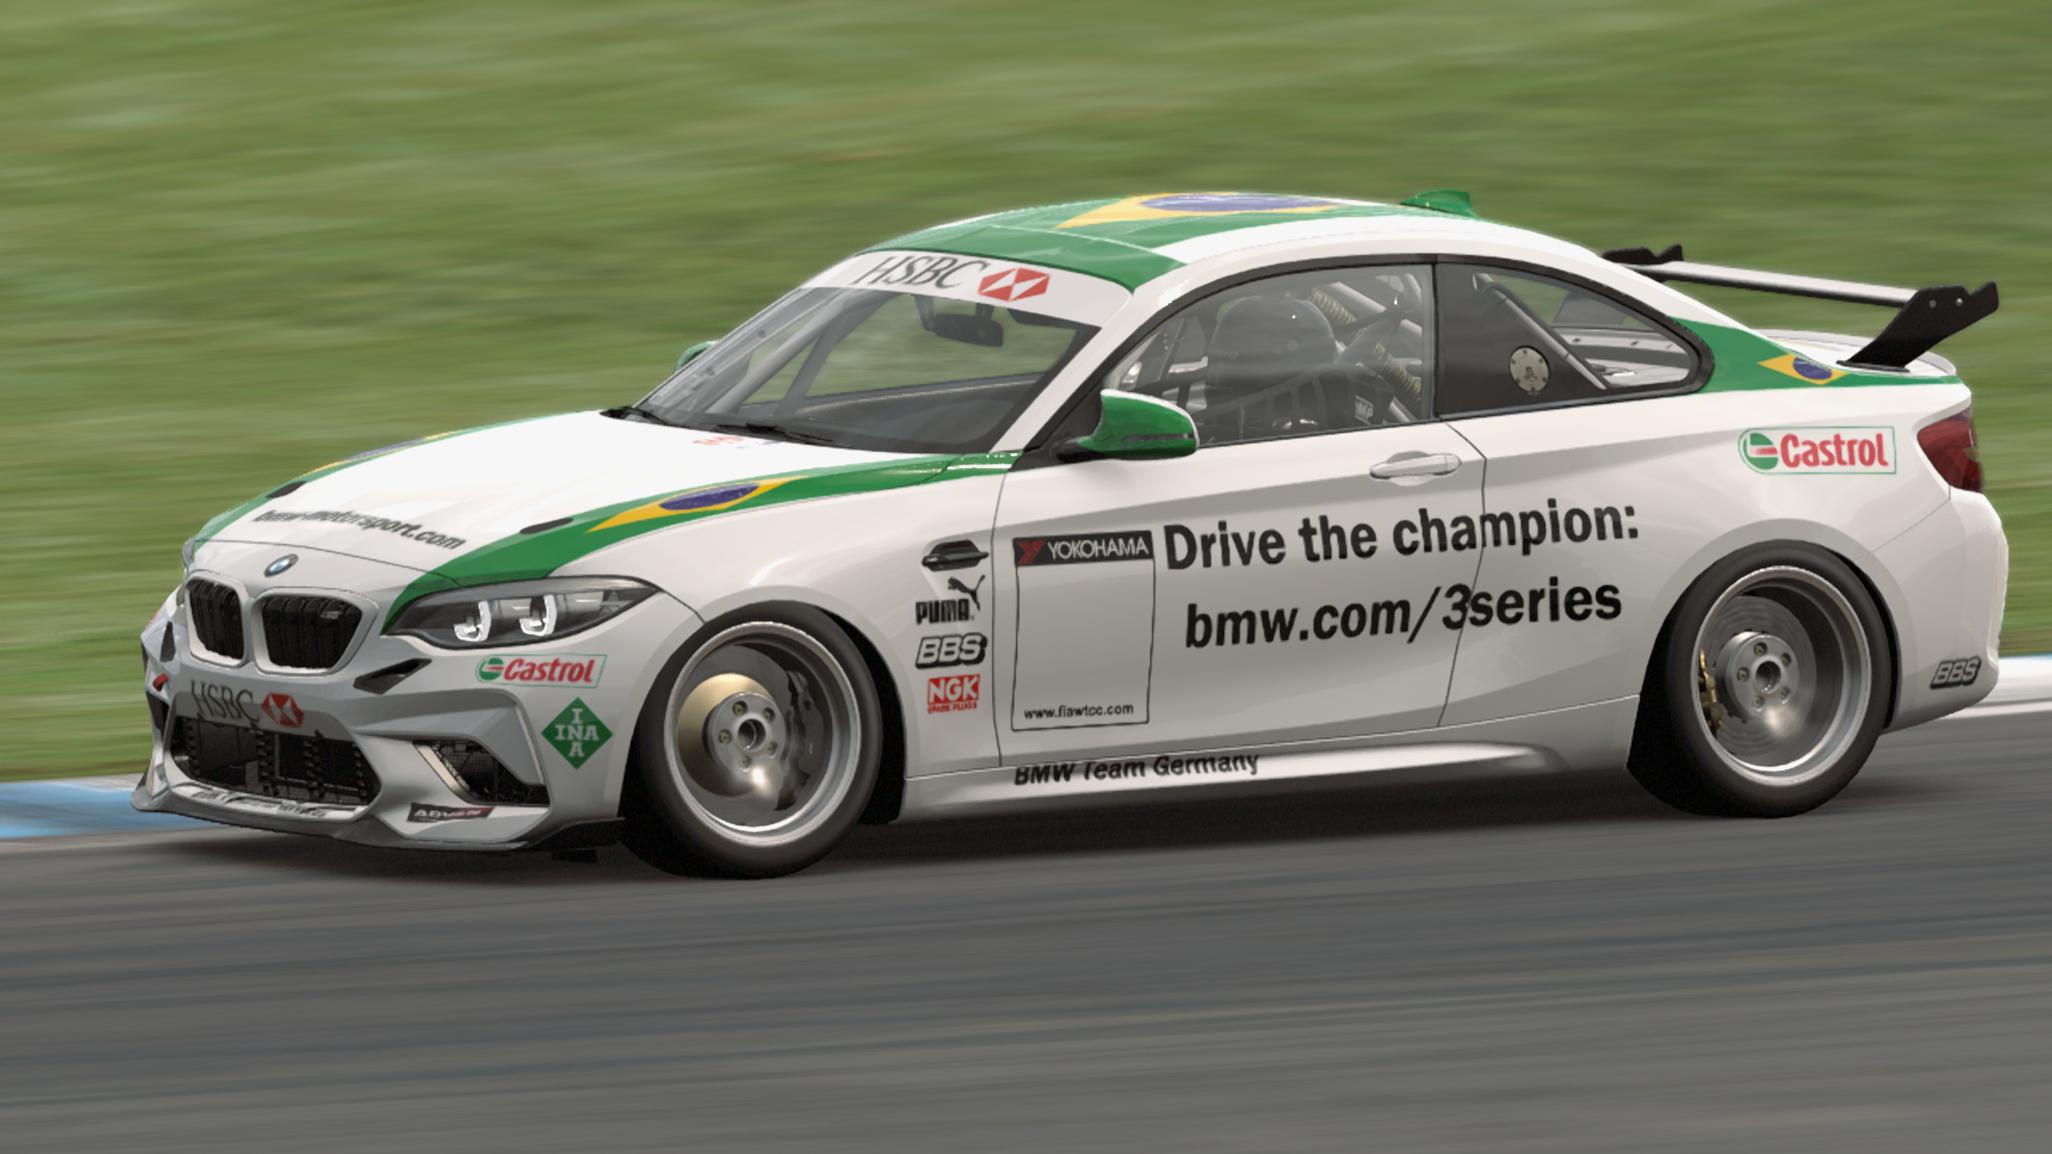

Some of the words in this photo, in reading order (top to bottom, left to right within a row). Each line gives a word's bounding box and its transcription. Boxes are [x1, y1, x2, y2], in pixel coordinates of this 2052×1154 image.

[852, 256, 990, 288] HSBC
[1779, 433, 1889, 468] Castrol
[1047, 537, 1149, 560] YOKOHAMA
[1163, 520, 1286, 570] Drive
[1298, 514, 1378, 562] the
[1392, 498, 1639, 556] champion:
[915, 600, 971, 625] PUMA
[1185, 576, 1622, 648] bmw.com/3series
[915, 632, 988, 669] BBS
[504, 656, 594, 684] Castrol
[1930, 656, 1982, 690] BBS
[190, 679, 259, 722] HSBC
[928, 675, 979, 703] NGK
[1023, 703, 1134, 721] www.fiawtcc.com
[1014, 764, 1076, 786] BMW
[1084, 760, 1146, 781] Team
[1152, 753, 1260, 778] Germany
